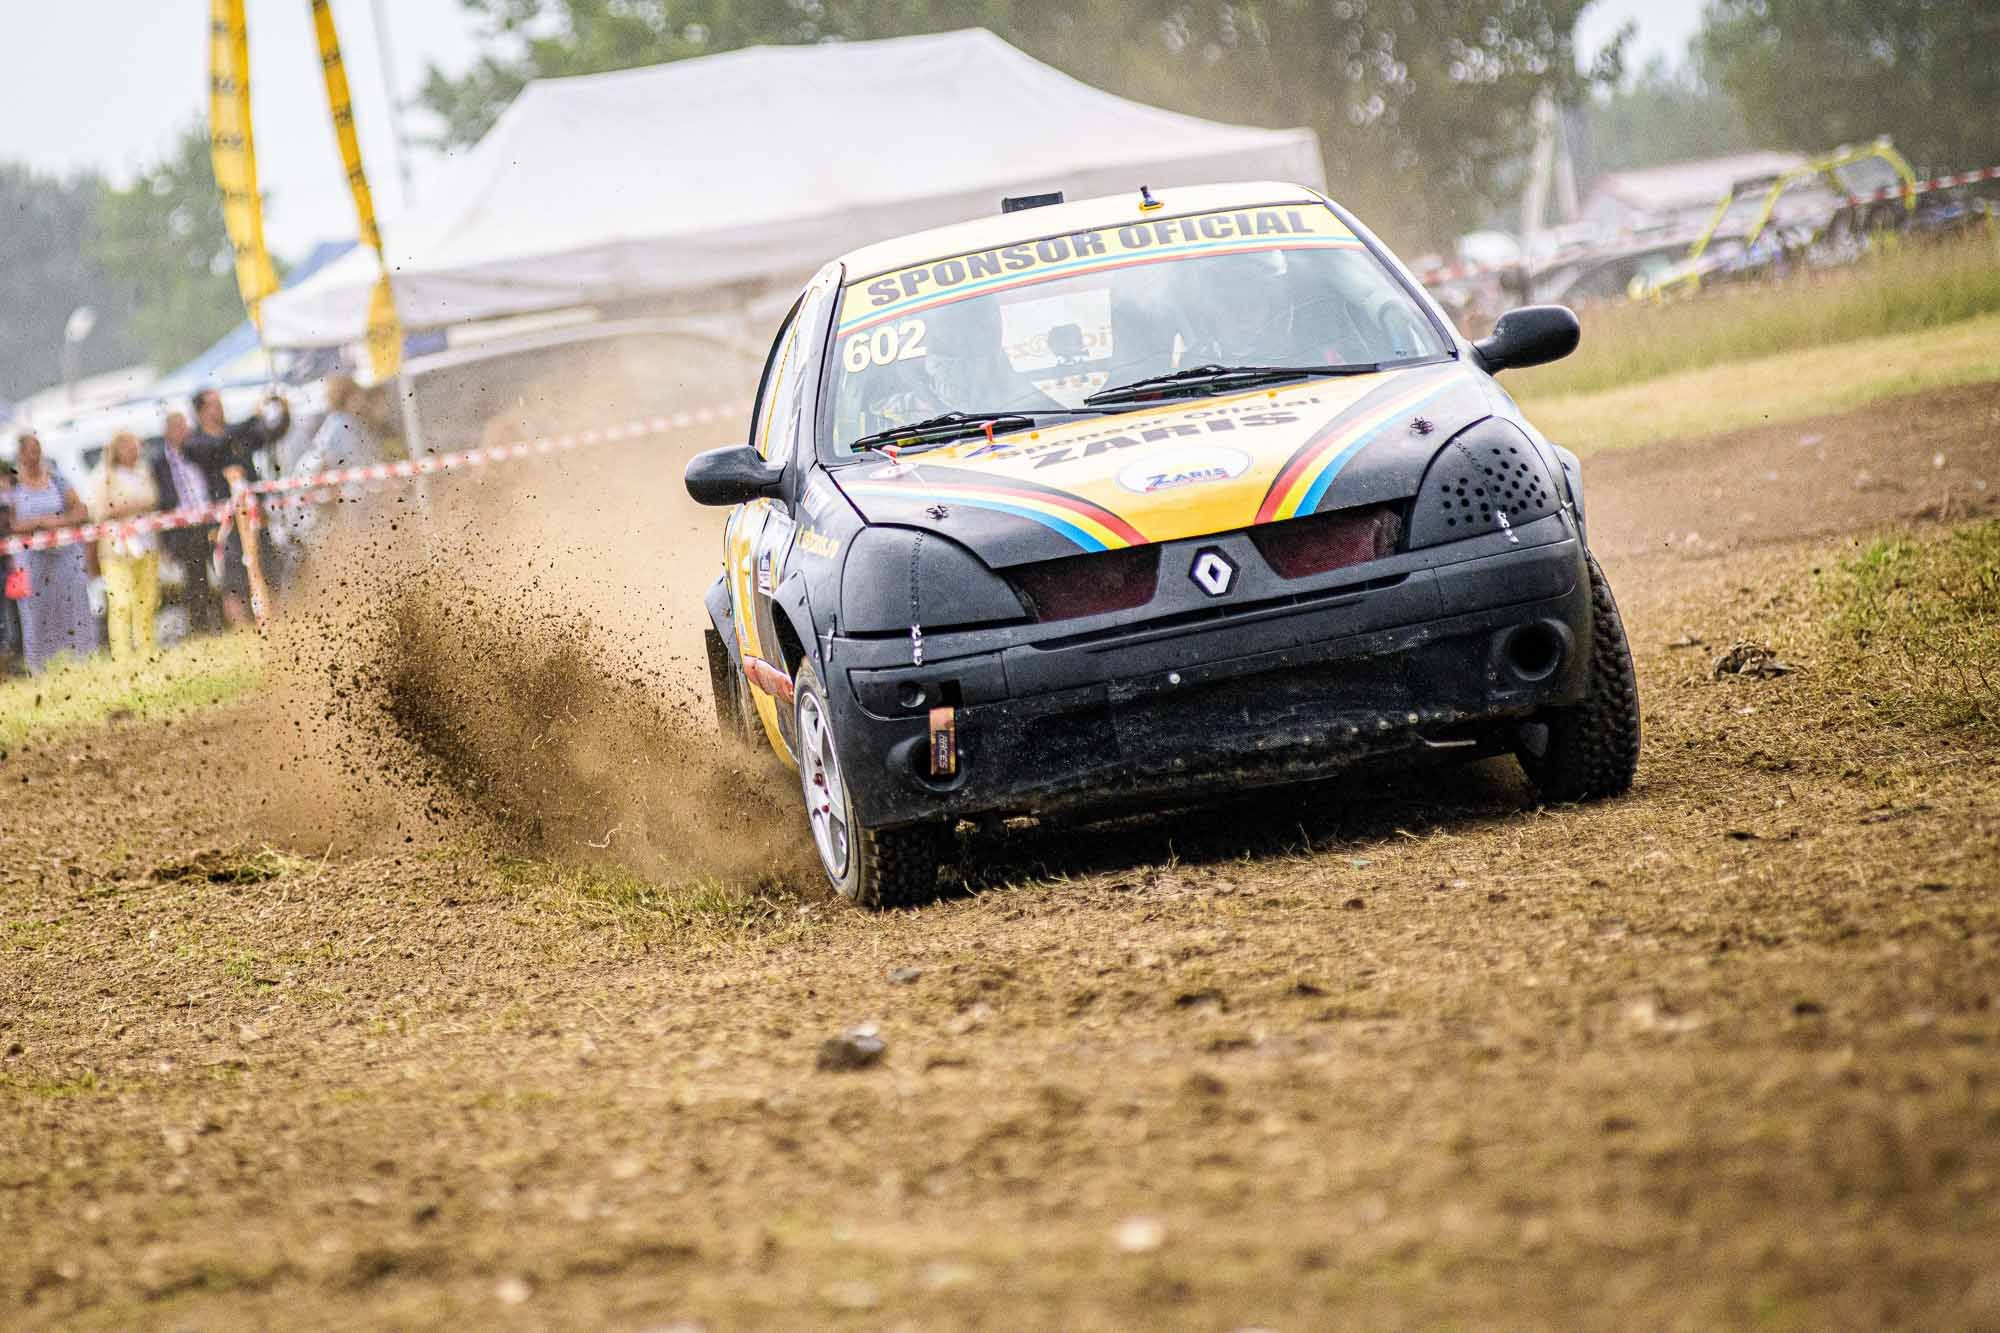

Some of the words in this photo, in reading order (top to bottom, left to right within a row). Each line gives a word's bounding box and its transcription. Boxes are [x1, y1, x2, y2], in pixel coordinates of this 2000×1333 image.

[868, 231, 1106, 307] SPONSOR
[1120, 209, 1316, 249] OFICIAL
[843, 319, 927, 373] 602
[998, 417, 1167, 459] Sponsor
[1184, 398, 1320, 419] Oficial
[1030, 411, 1299, 470] ZARIS
